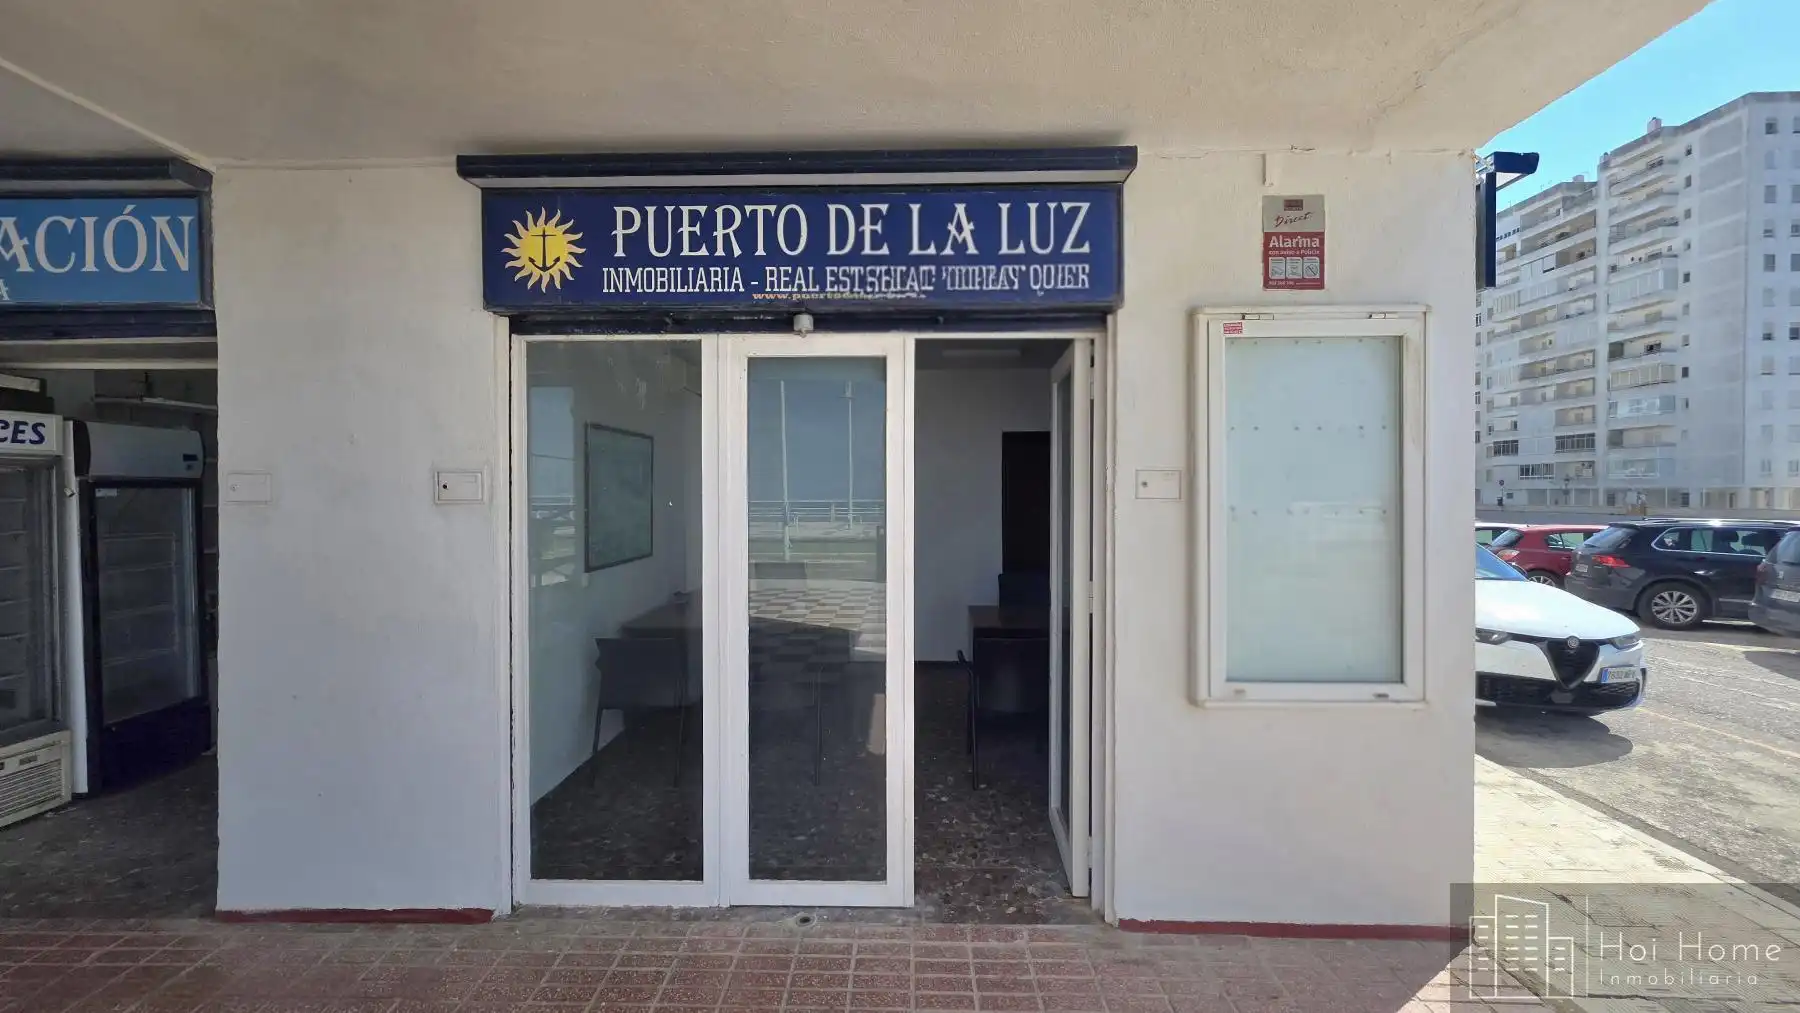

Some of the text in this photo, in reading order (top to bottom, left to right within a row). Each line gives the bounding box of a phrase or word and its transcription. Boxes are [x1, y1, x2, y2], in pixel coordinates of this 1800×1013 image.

[611, 202, 1091, 257] PUERTO DE LA LUZ
[1269, 234, 1320, 248] Alarma
[602, 267, 745, 293] INMOBILIARIA
[765, 266, 820, 292] REAL
